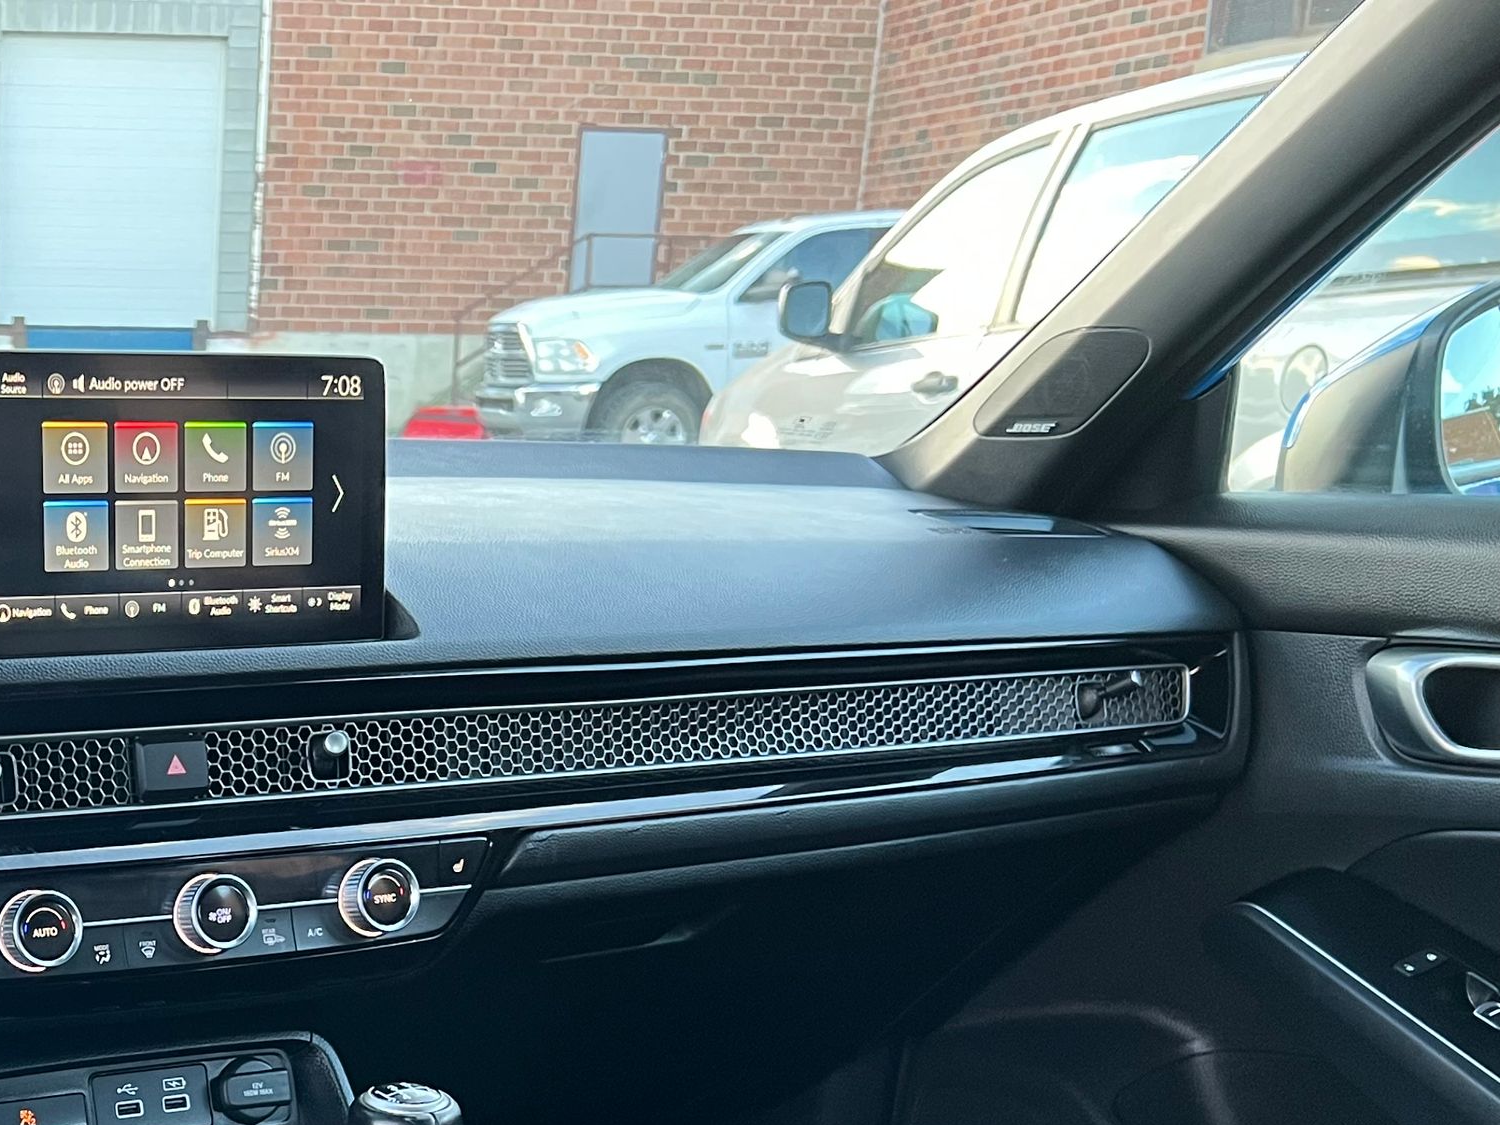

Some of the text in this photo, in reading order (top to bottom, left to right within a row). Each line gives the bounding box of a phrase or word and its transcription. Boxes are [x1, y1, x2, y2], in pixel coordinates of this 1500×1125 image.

[2, 372, 26, 383] Audio
[0, 385, 27, 395] Source
[89, 377, 185, 393] Audio power OFF
[321, 374, 362, 397] 7:08
[1006, 420, 1057, 433] BOSE
[58, 474, 94, 486] All Apps
[124, 473, 169, 485] Navigation
[202, 472, 229, 483] Phone
[275, 471, 290, 482] FM
[55, 545, 98, 556] Bluetooth
[122, 544, 172, 555] Smartphone
[187, 548, 244, 560] Trip Computer
[264, 546, 300, 558] SiriusXM
[64, 558, 89, 569] Audio
[123, 556, 171, 567] Connection
[271, 593, 292, 603] Smart
[327, 591, 354, 602] Display
[84, 604, 109, 616] Phone
[152, 602, 167, 613] FM
[210, 606, 232, 616] Audio
[329, 601, 351, 611] Mode
[12, 606, 53, 619] Navigation
[373, 893, 397, 905] SYNC
[217, 914, 233, 924] OFF
[32, 927, 58, 938] AUTO
[307, 927, 324, 938] A/C
